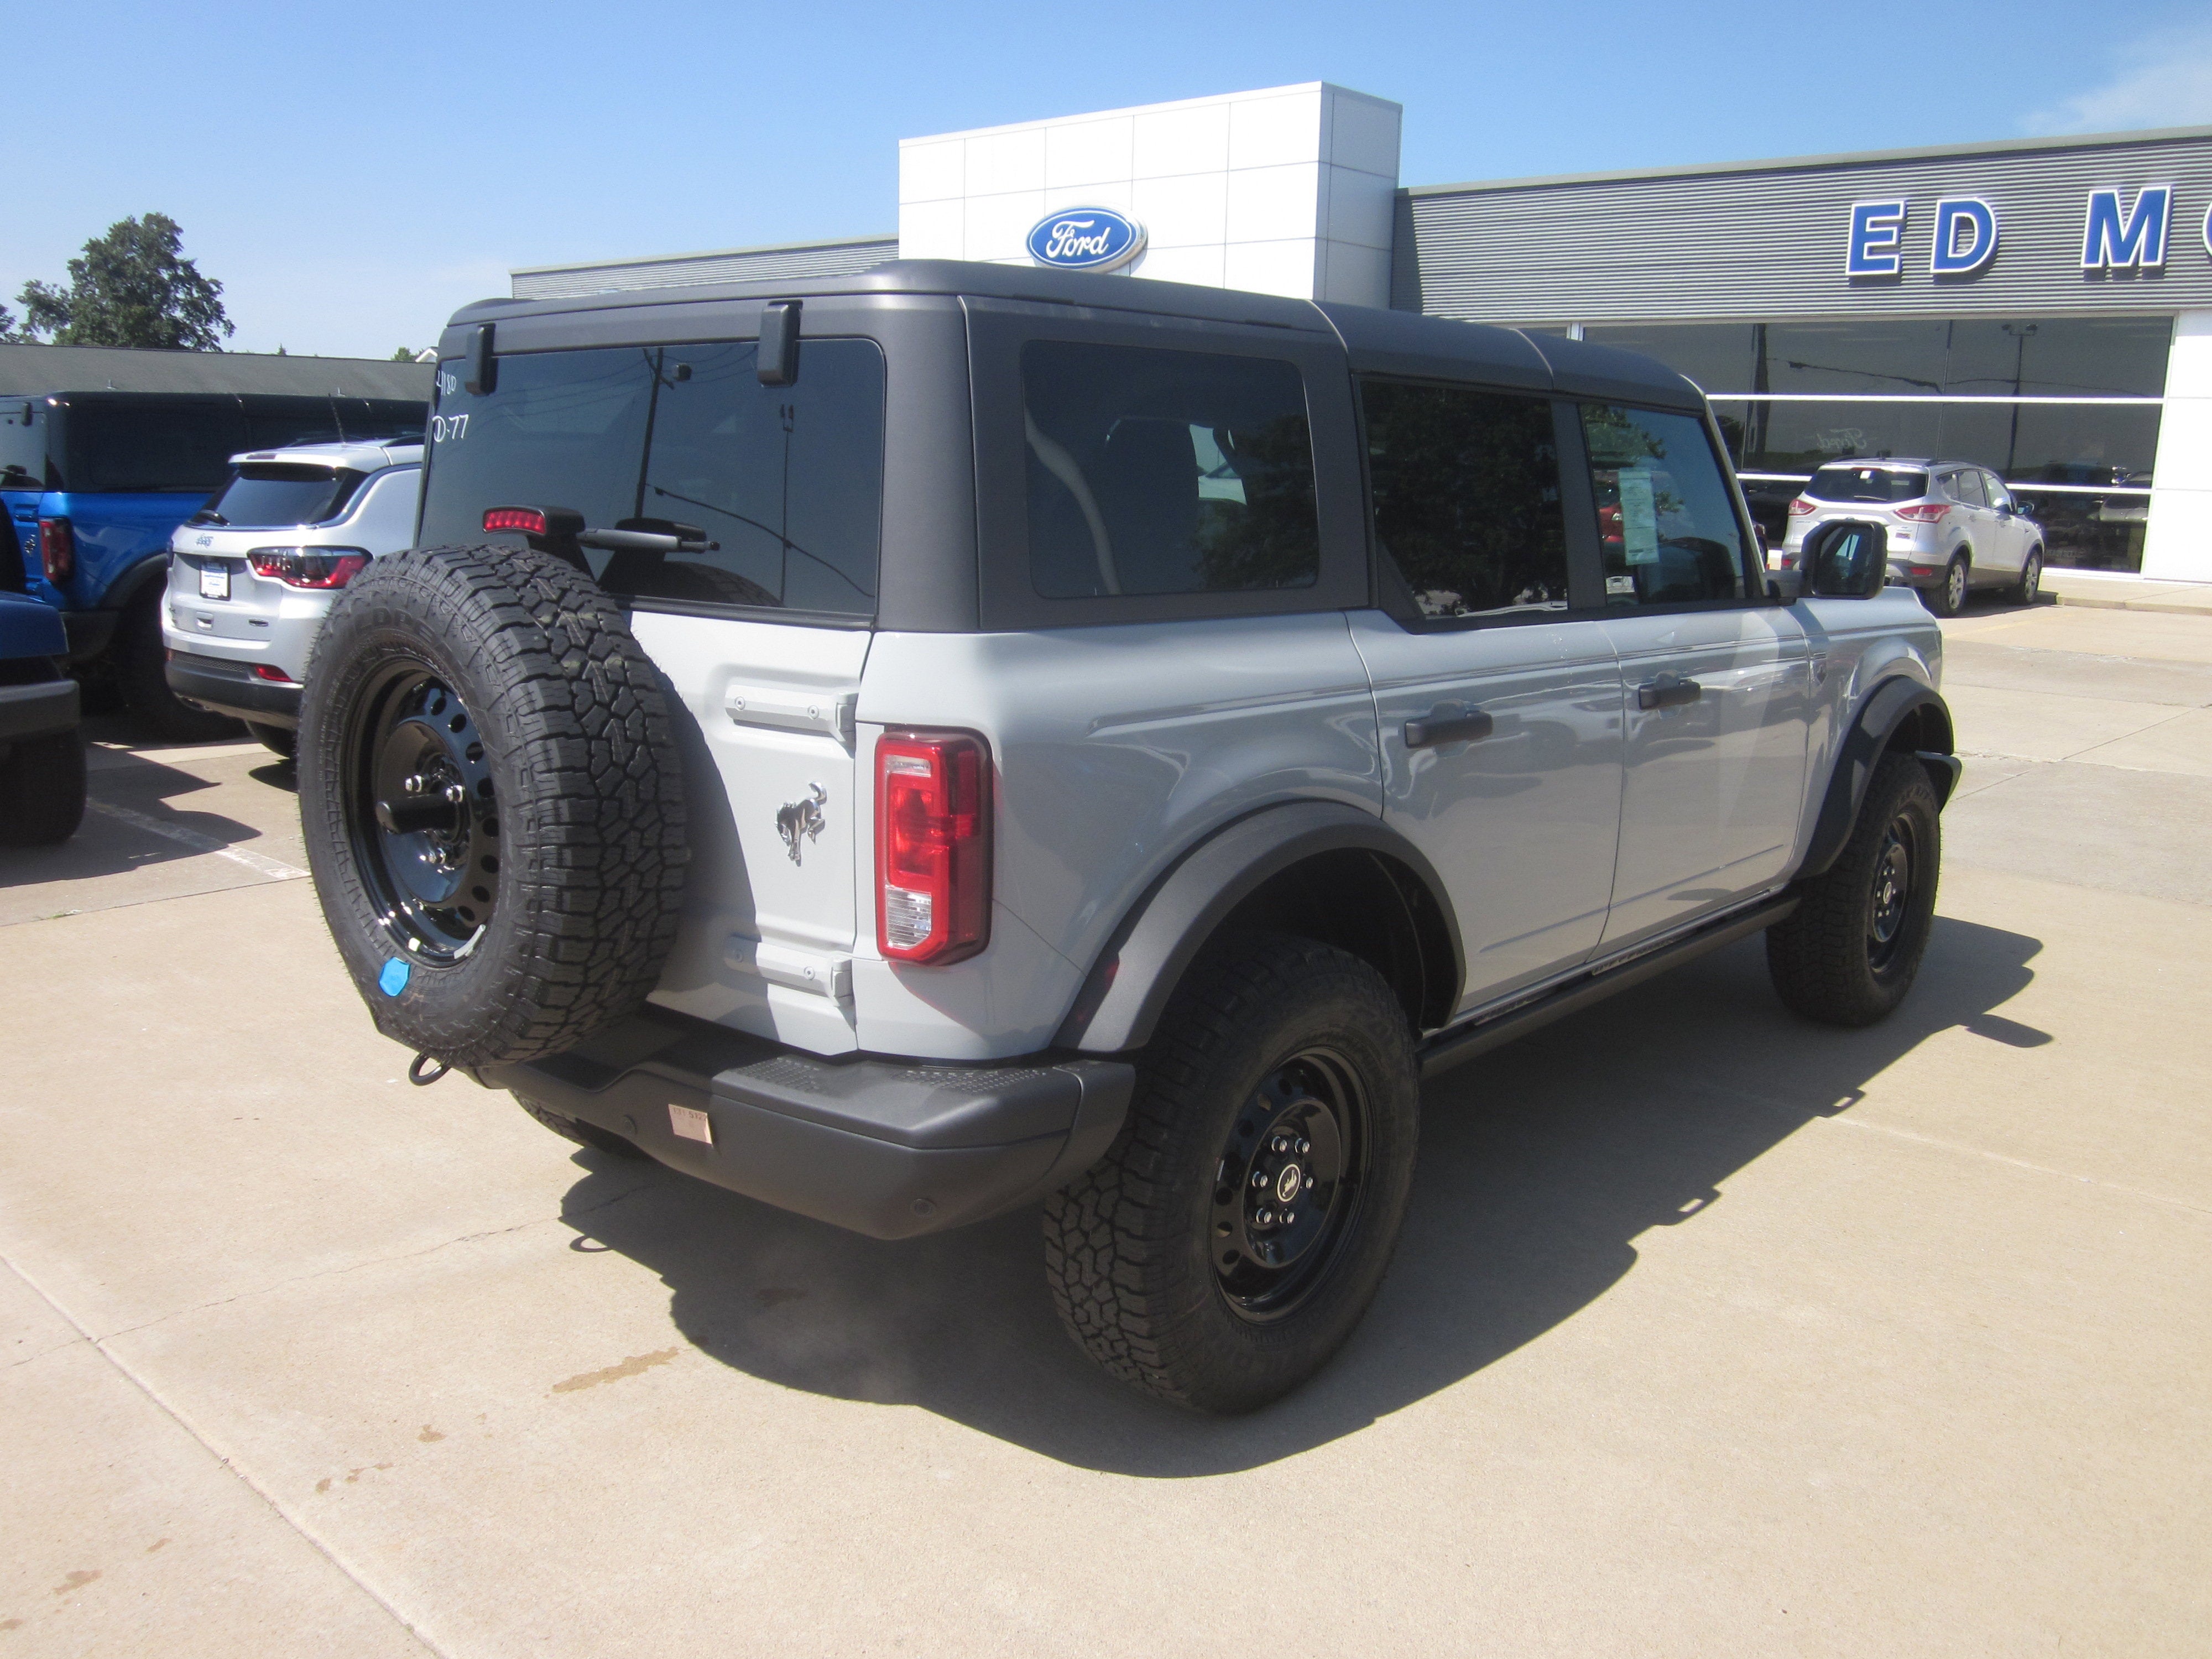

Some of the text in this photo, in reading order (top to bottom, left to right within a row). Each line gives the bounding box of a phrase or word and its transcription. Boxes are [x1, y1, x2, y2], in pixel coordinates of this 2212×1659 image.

[1046, 220, 1110, 258] Ford
[1845, 185, 2212, 275] ED M
